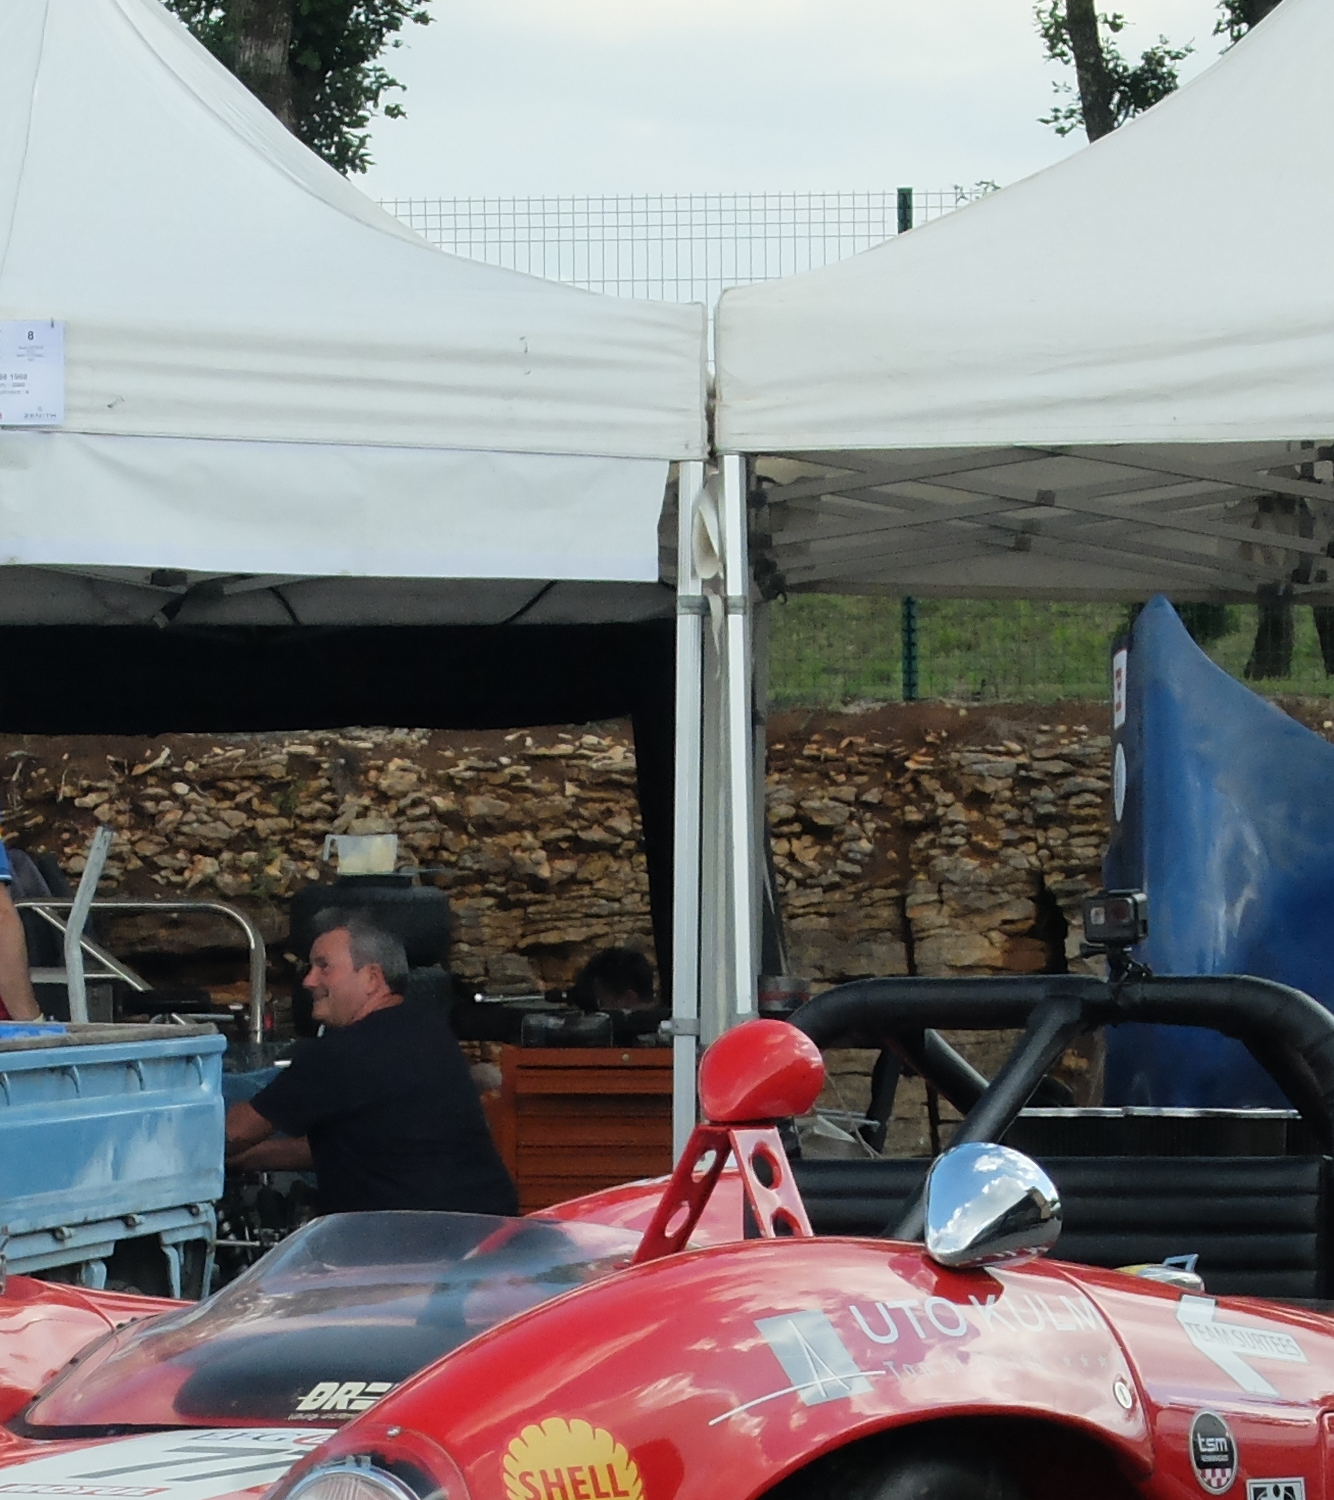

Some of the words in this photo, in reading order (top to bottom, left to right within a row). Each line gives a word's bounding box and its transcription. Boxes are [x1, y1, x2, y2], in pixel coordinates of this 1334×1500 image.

[27, 331, 34, 340] 8
[849, 1296, 967, 1344] UTO
[969, 1294, 1110, 1333] KULM
[1184, 1321, 1229, 1346] TEAM
[1231, 1328, 1302, 1357] SURTEES
[296, 1382, 399, 1411] DRE
[1197, 1432, 1228, 1452] tsm
